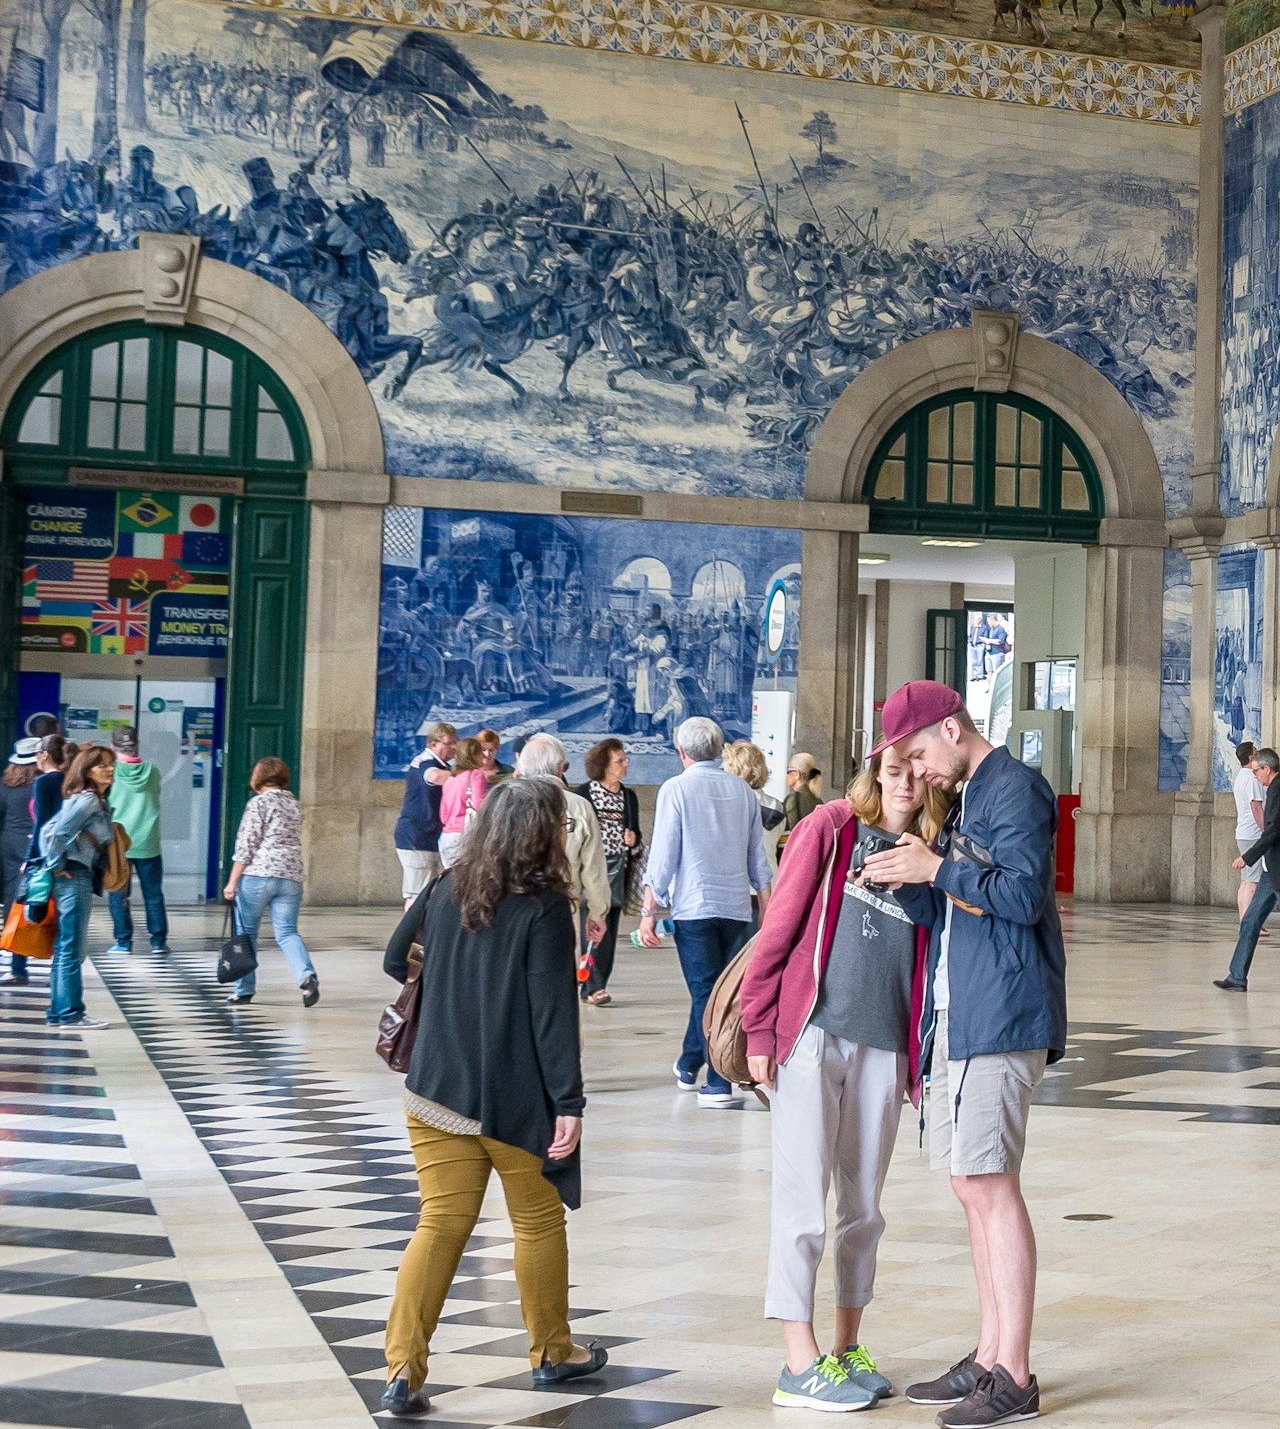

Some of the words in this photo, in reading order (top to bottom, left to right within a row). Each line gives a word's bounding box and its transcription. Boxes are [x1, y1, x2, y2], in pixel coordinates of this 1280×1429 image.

[31, 519, 84, 533] CHANGE
[161, 621, 206, 634] MONEY
[859, 891, 869, 900] TO
[800, 1374, 829, 1395] N
